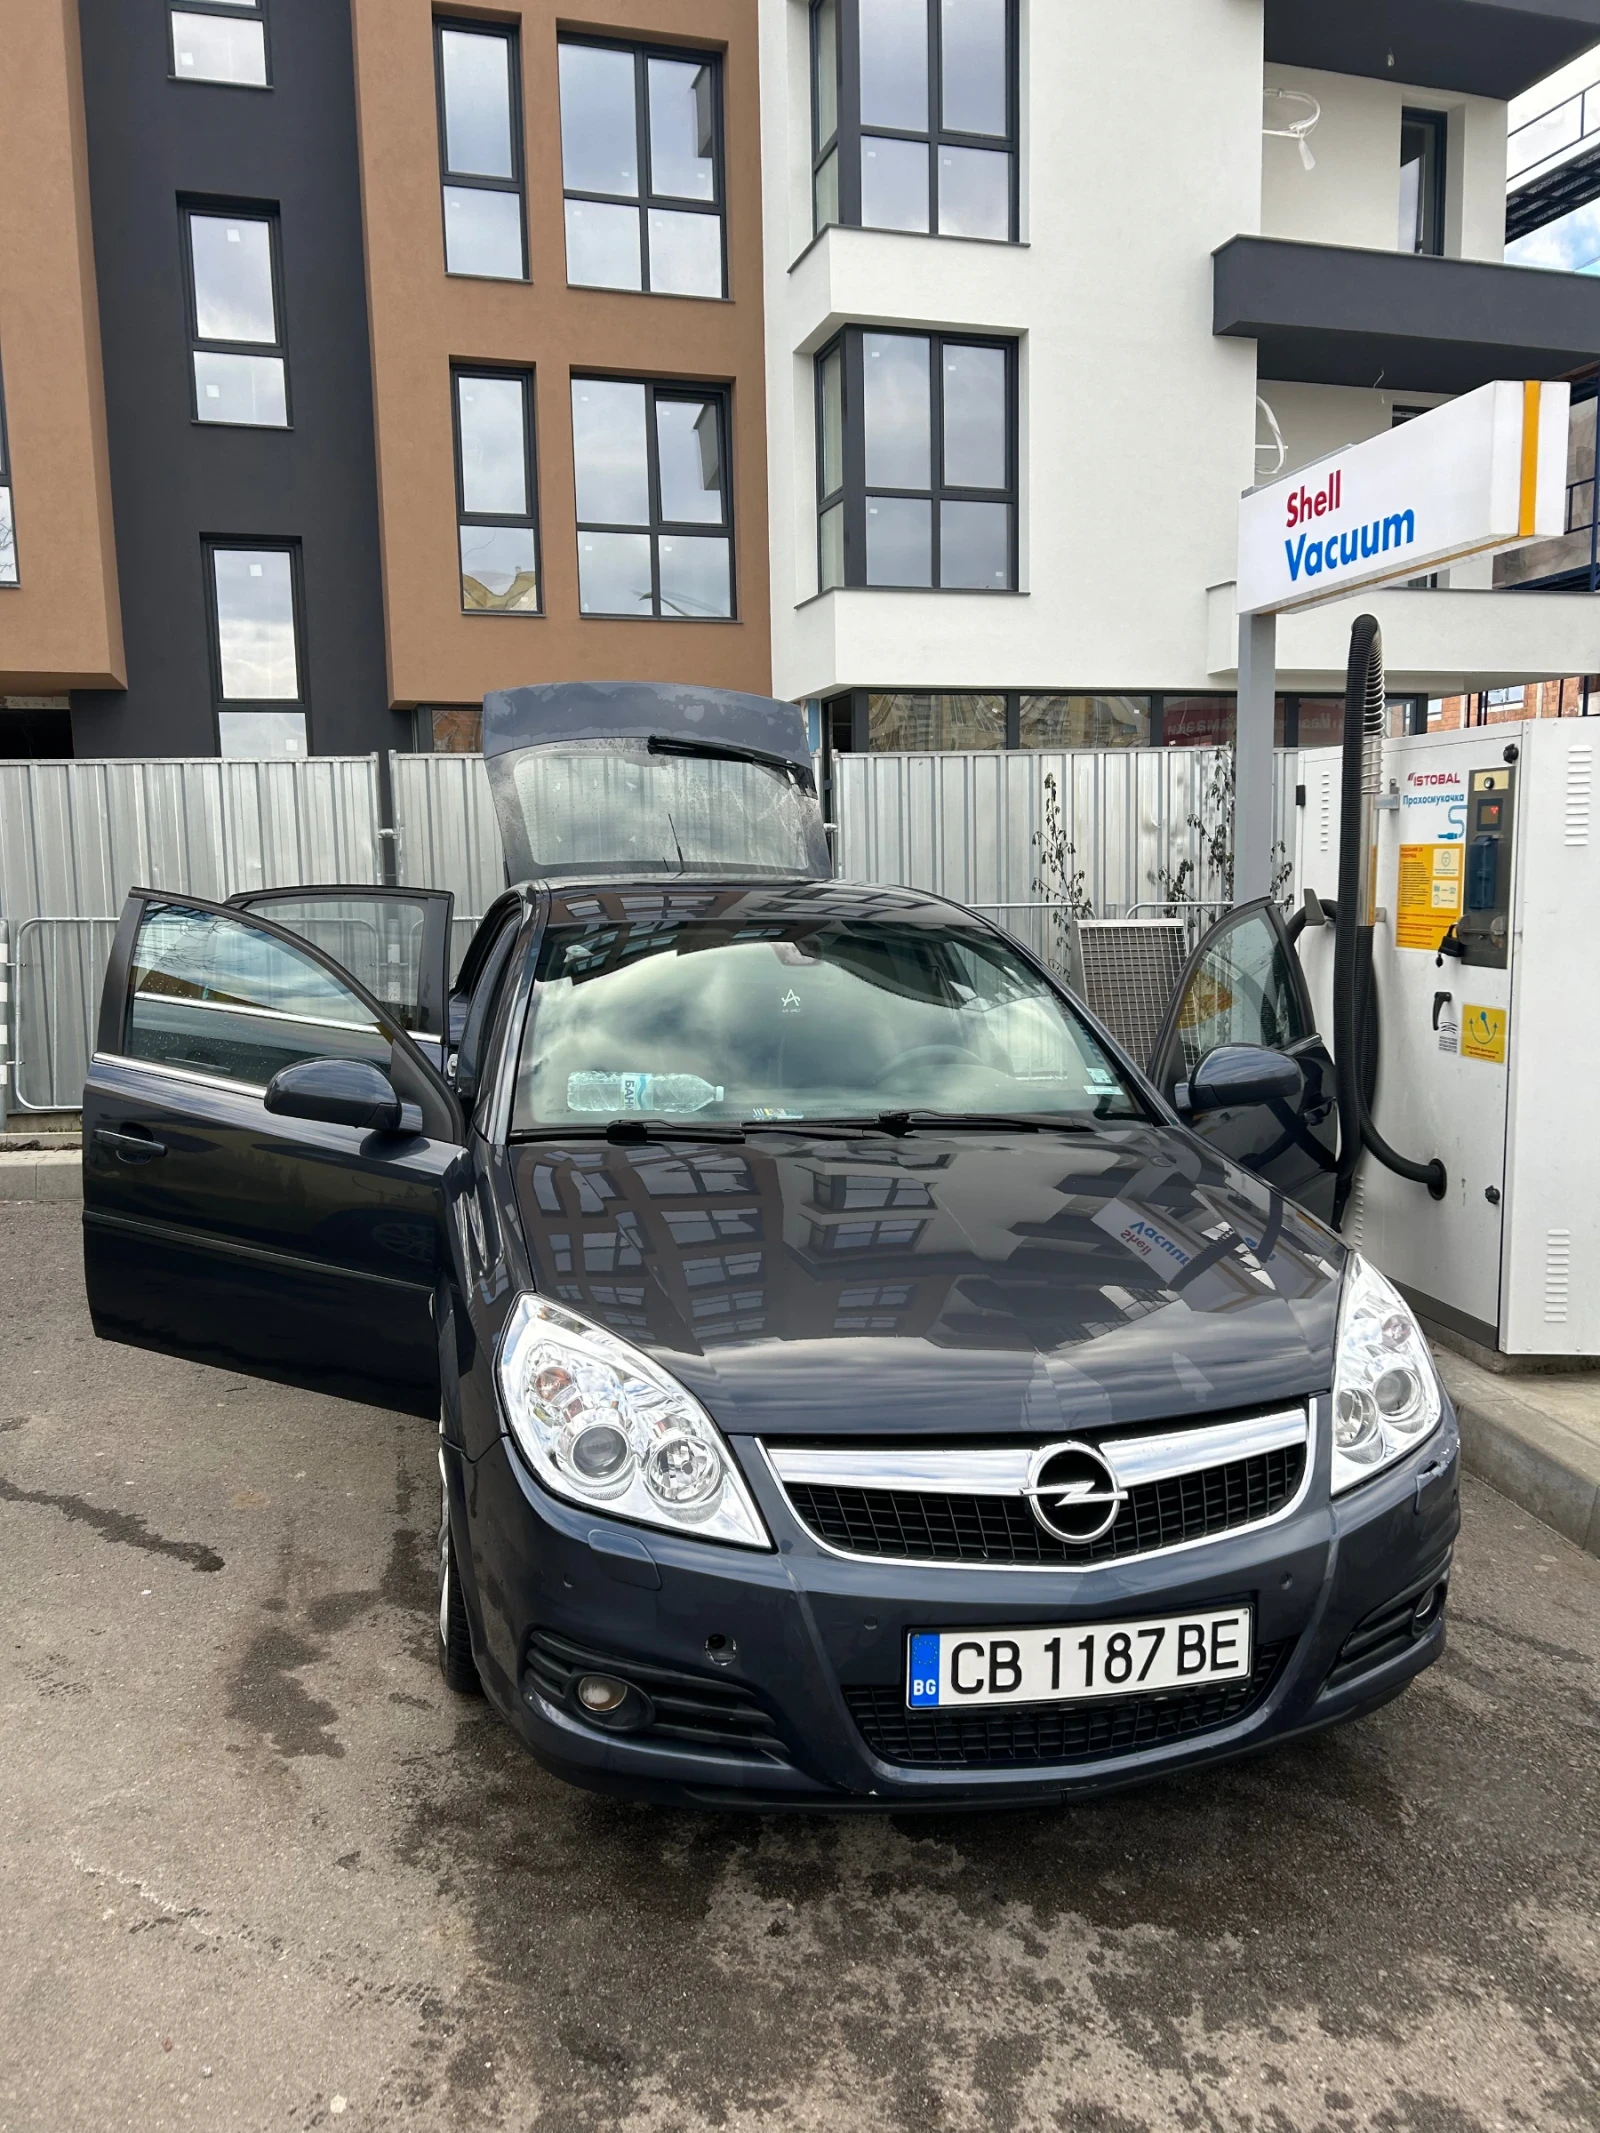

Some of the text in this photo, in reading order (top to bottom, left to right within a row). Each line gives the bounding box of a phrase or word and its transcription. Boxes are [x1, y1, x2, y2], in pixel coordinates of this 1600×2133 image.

[1286, 469, 1342, 528] Shell
[1284, 508, 1415, 582] Vacuum
[1413, 773, 1461, 787] ISTOBAL
[1403, 794, 1464, 808] Прахосмукачка
[950, 1618, 1240, 1695] CB 1187 BE
[913, 1679, 936, 1697] BG
